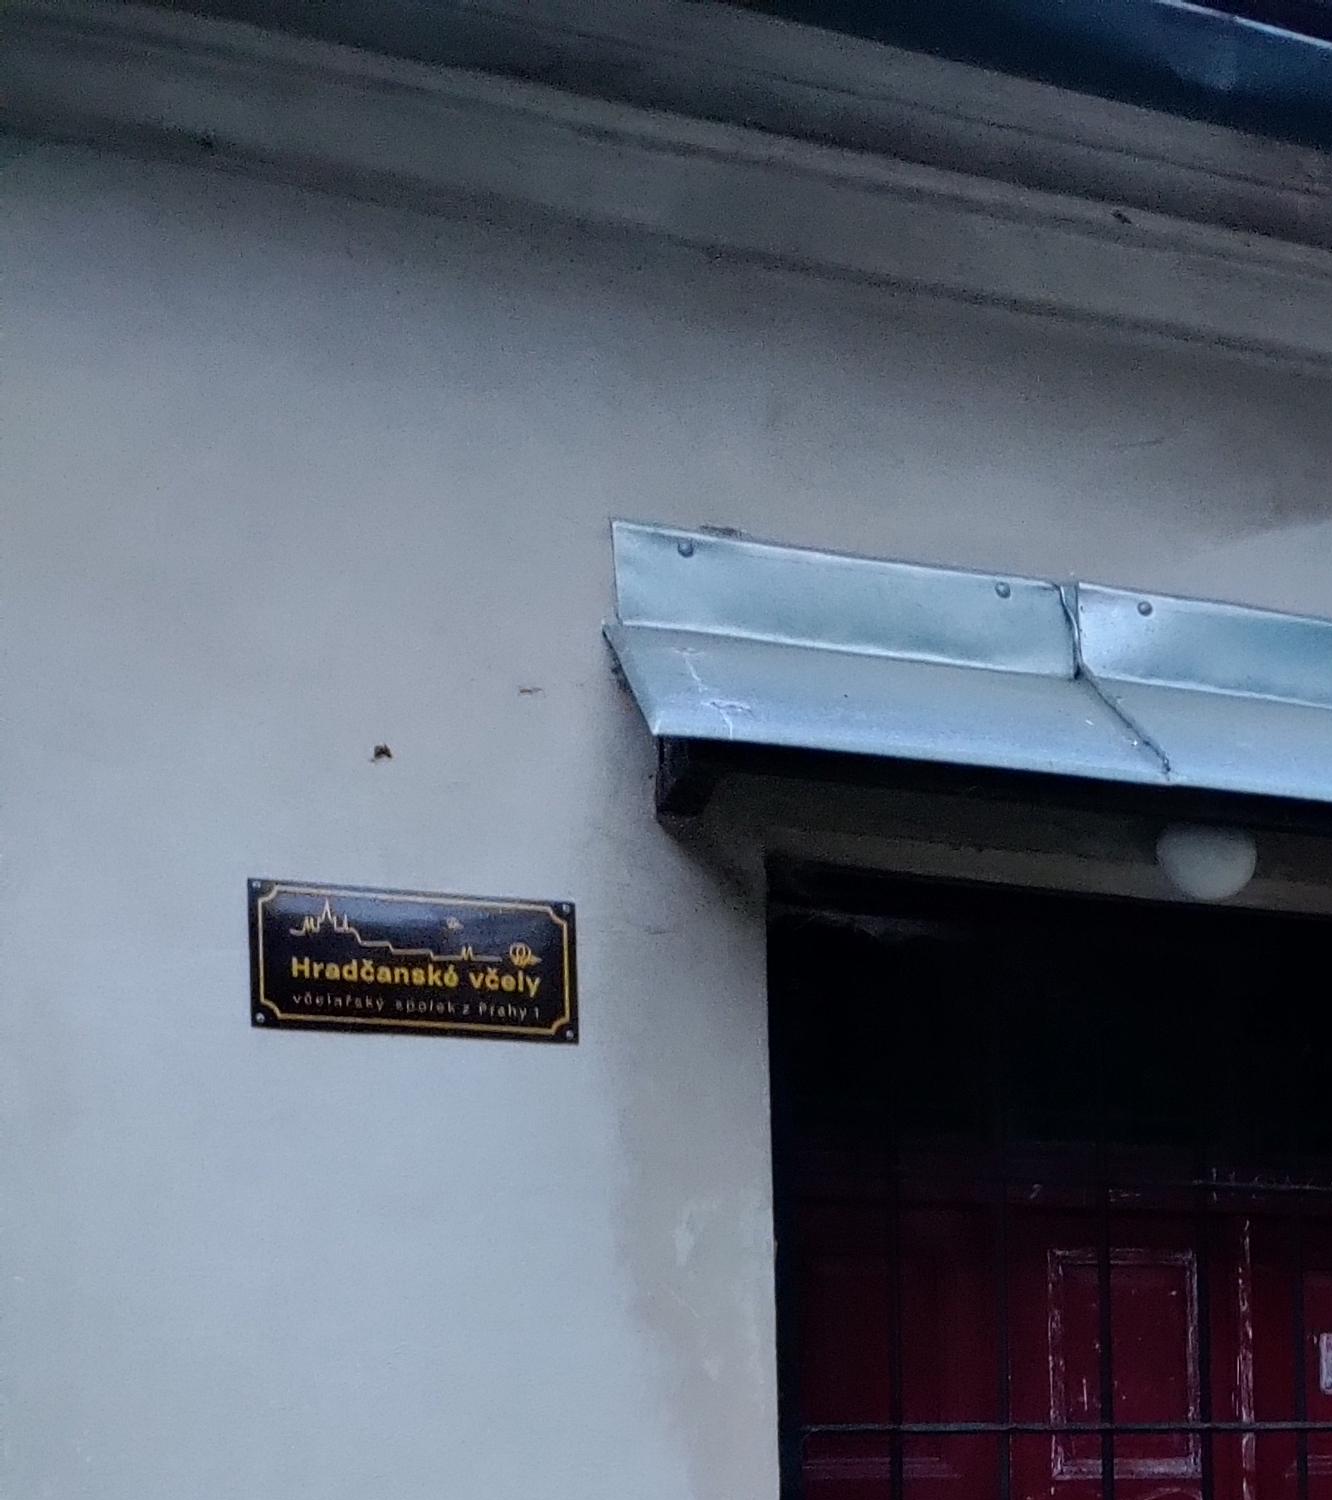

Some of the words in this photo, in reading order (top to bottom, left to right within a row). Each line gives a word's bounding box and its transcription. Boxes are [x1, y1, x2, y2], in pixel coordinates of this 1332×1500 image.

[291, 956, 460, 988] Hradčanské
[469, 966, 541, 998] včely
[395, 999, 456, 1015] spolek
[462, 1003, 471, 1016] z
[479, 1001, 528, 1022] Prahy
